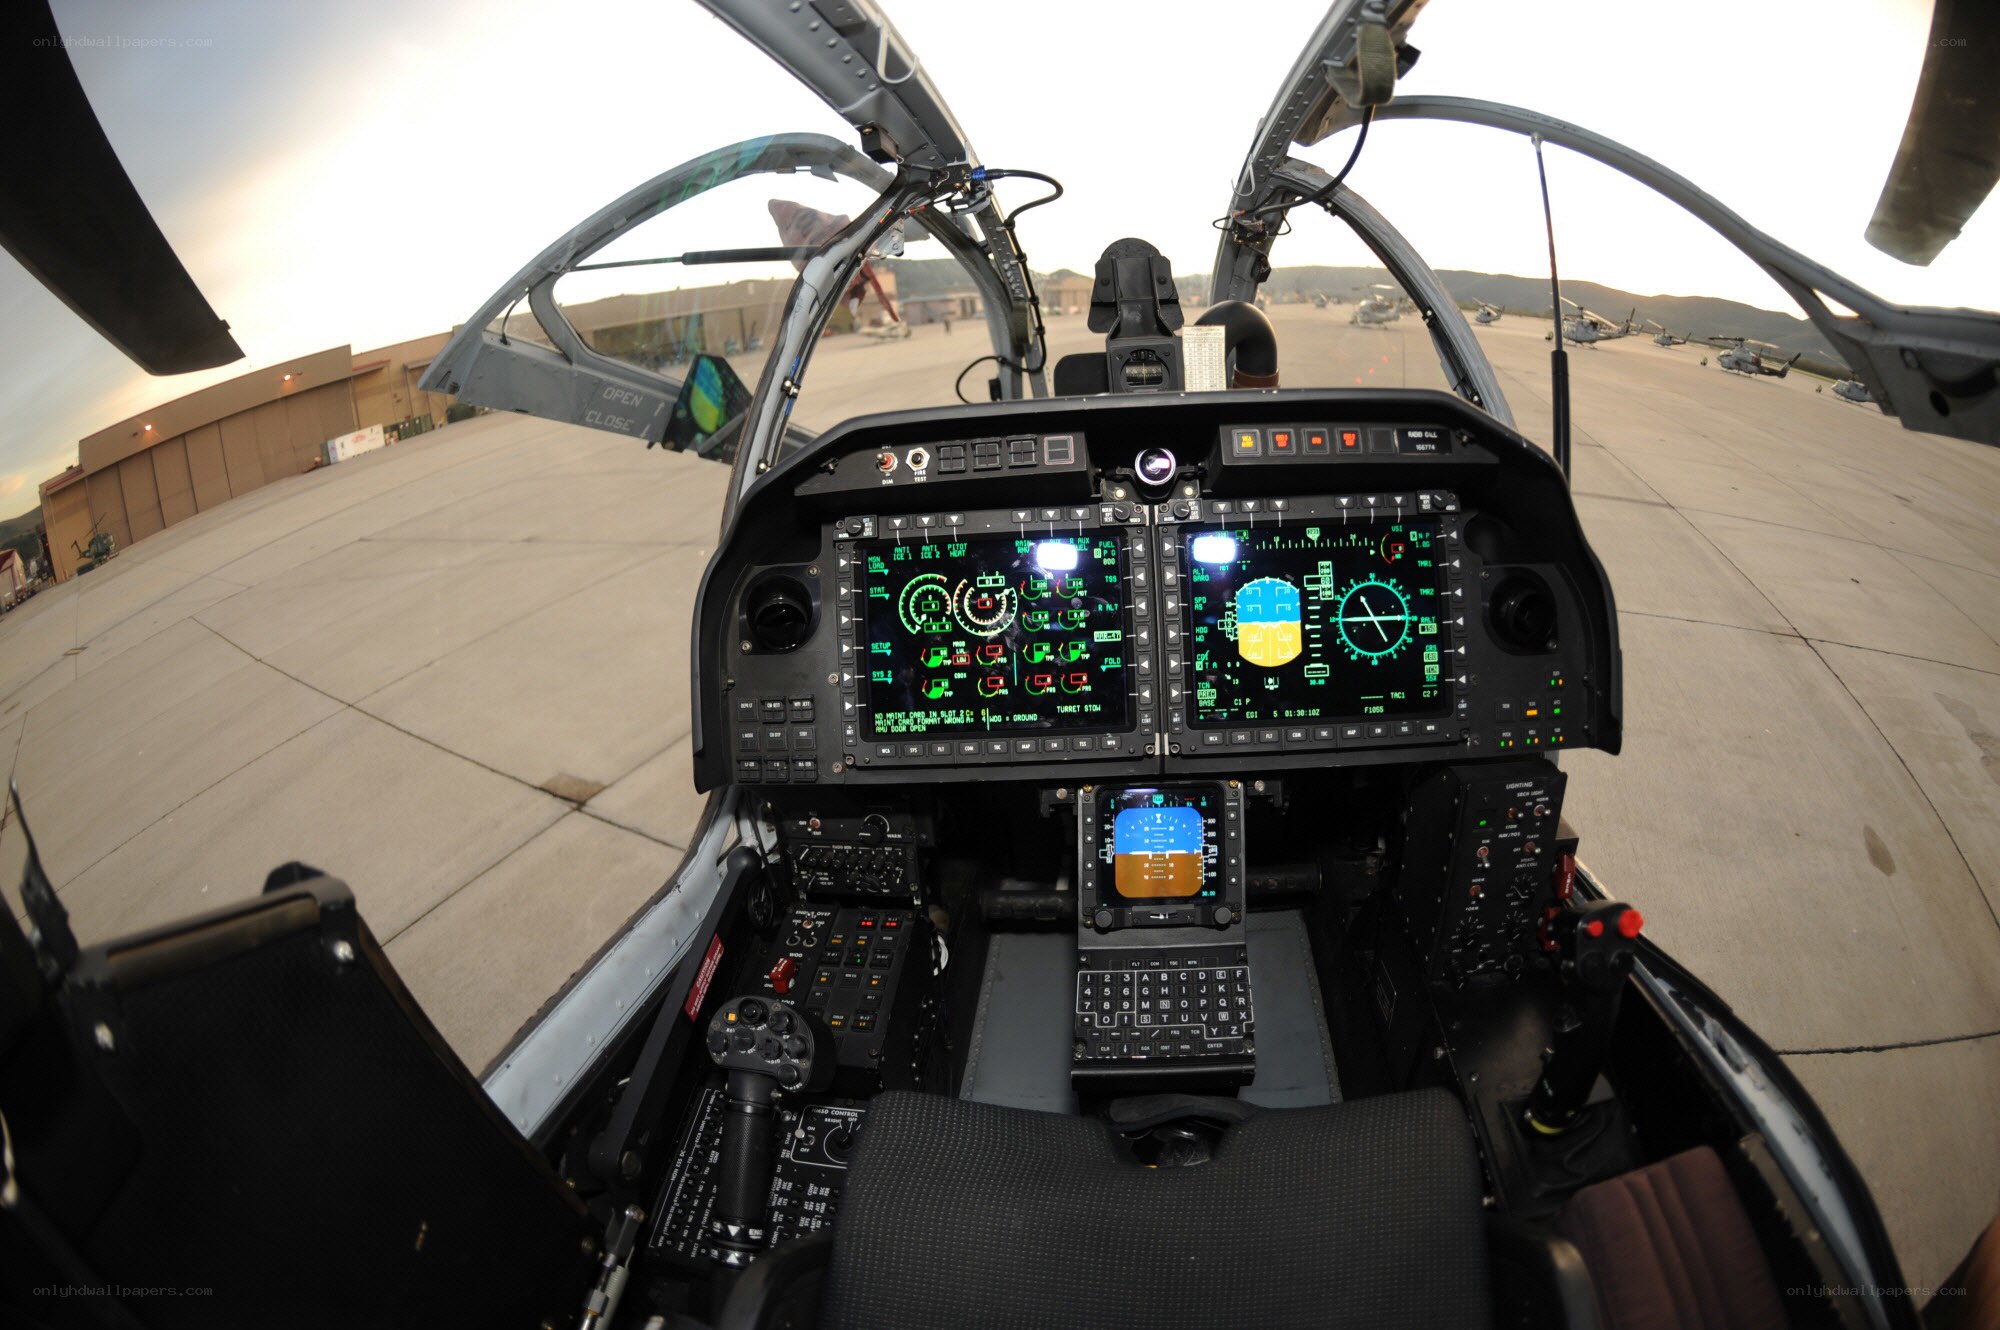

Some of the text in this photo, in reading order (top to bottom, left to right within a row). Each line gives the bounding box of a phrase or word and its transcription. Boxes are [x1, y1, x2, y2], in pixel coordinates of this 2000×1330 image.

[602, 387, 643, 407] OPEN
[585, 410, 635, 431] CLOSE
[1124, 974, 1130, 982] 3
[1162, 1014, 1168, 1023] T
[1231, 1026, 1238, 1034] Z
